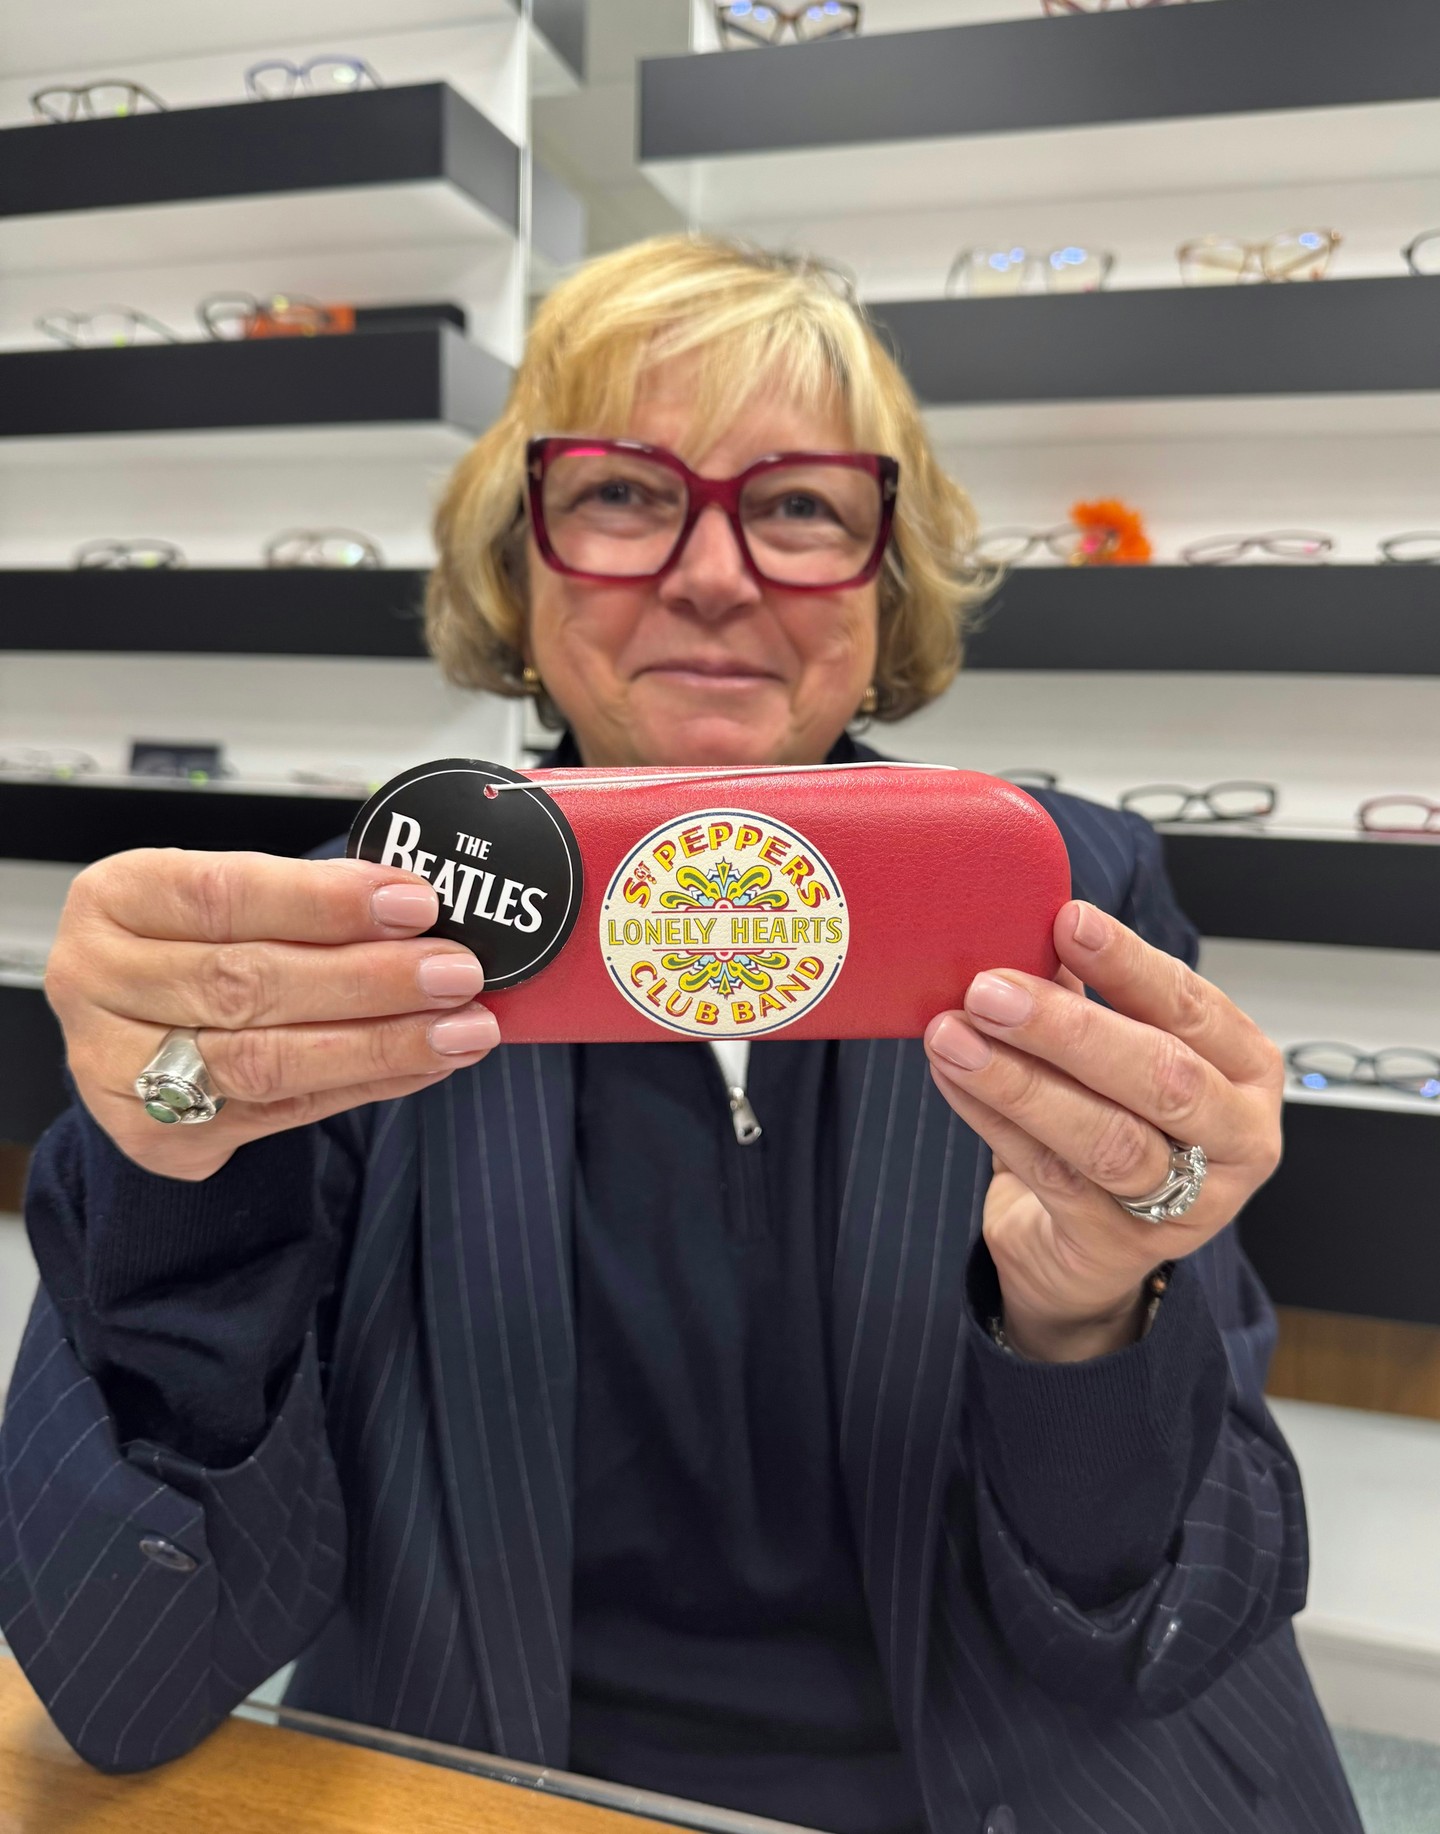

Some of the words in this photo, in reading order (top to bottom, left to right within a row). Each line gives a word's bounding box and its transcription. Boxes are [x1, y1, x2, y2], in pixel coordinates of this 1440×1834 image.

[455, 831, 493, 861] THE
[652, 821, 831, 908] PEPPERS
[607, 917, 717, 946] LONELY
[731, 916, 843, 944] HEARTS
[630, 960, 719, 1026] CLUB
[731, 956, 825, 1024] BAND
